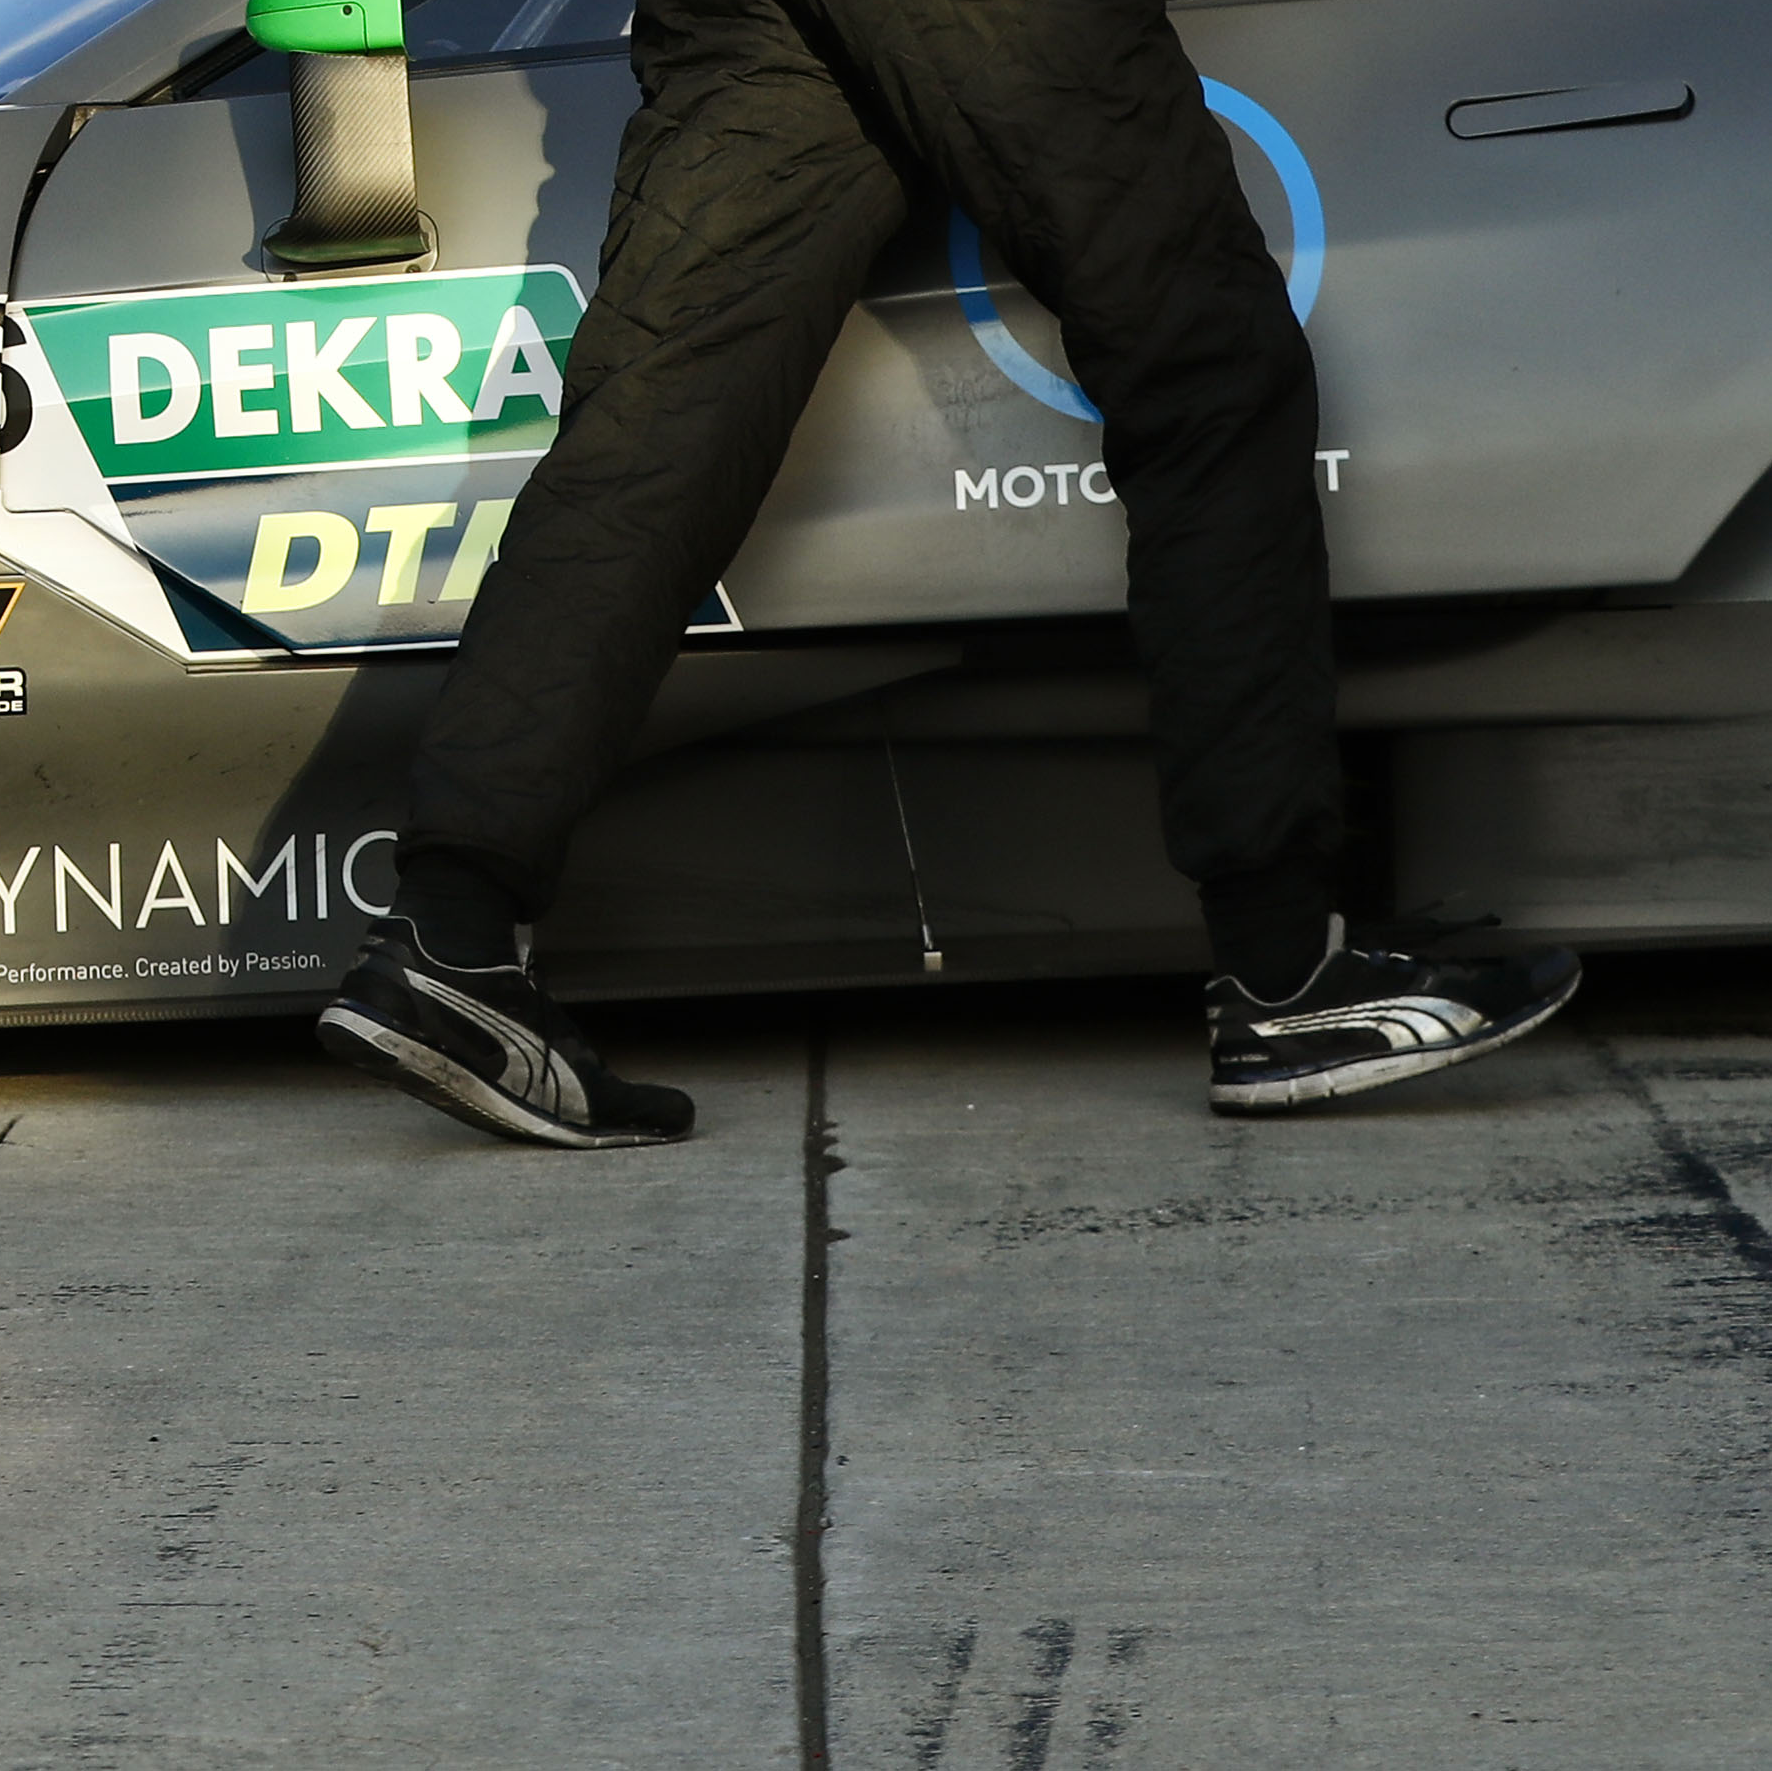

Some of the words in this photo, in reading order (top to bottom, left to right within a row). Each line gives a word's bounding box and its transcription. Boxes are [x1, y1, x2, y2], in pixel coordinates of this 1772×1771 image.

[108, 305, 563, 446] DEKRA
[136, 956, 213, 977] Created
[218, 954, 240, 978] by
[245, 950, 327, 972] Passion.
